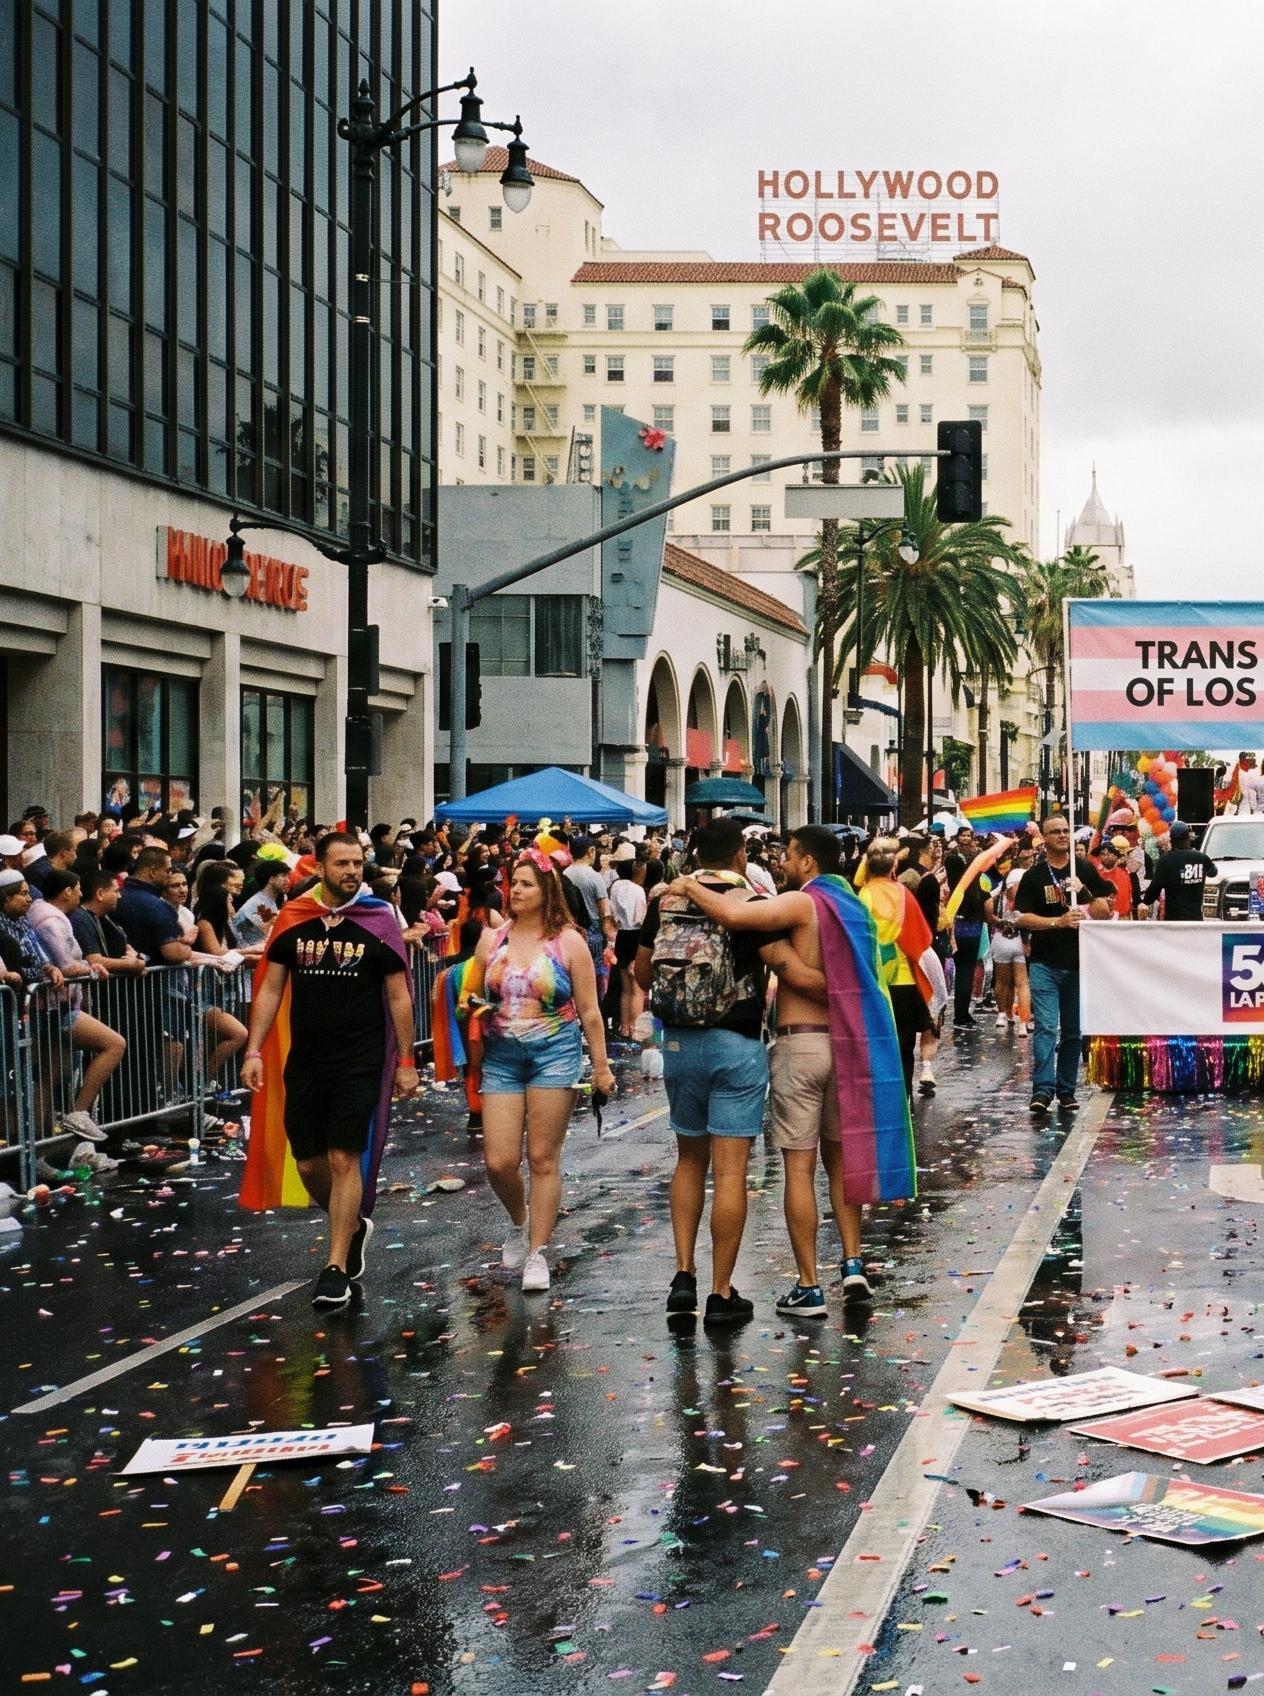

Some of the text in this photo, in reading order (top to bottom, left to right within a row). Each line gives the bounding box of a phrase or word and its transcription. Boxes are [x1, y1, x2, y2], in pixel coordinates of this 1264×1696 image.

[757, 169, 999, 200] HOLLYWOOD
[757, 212, 999, 242] ROOSEVELT
[1135, 640, 1258, 670] TRANS
[1125, 676, 1175, 708] OF
[1187, 676, 1257, 707] LOS
[1230, 991, 1255, 1008] LA
